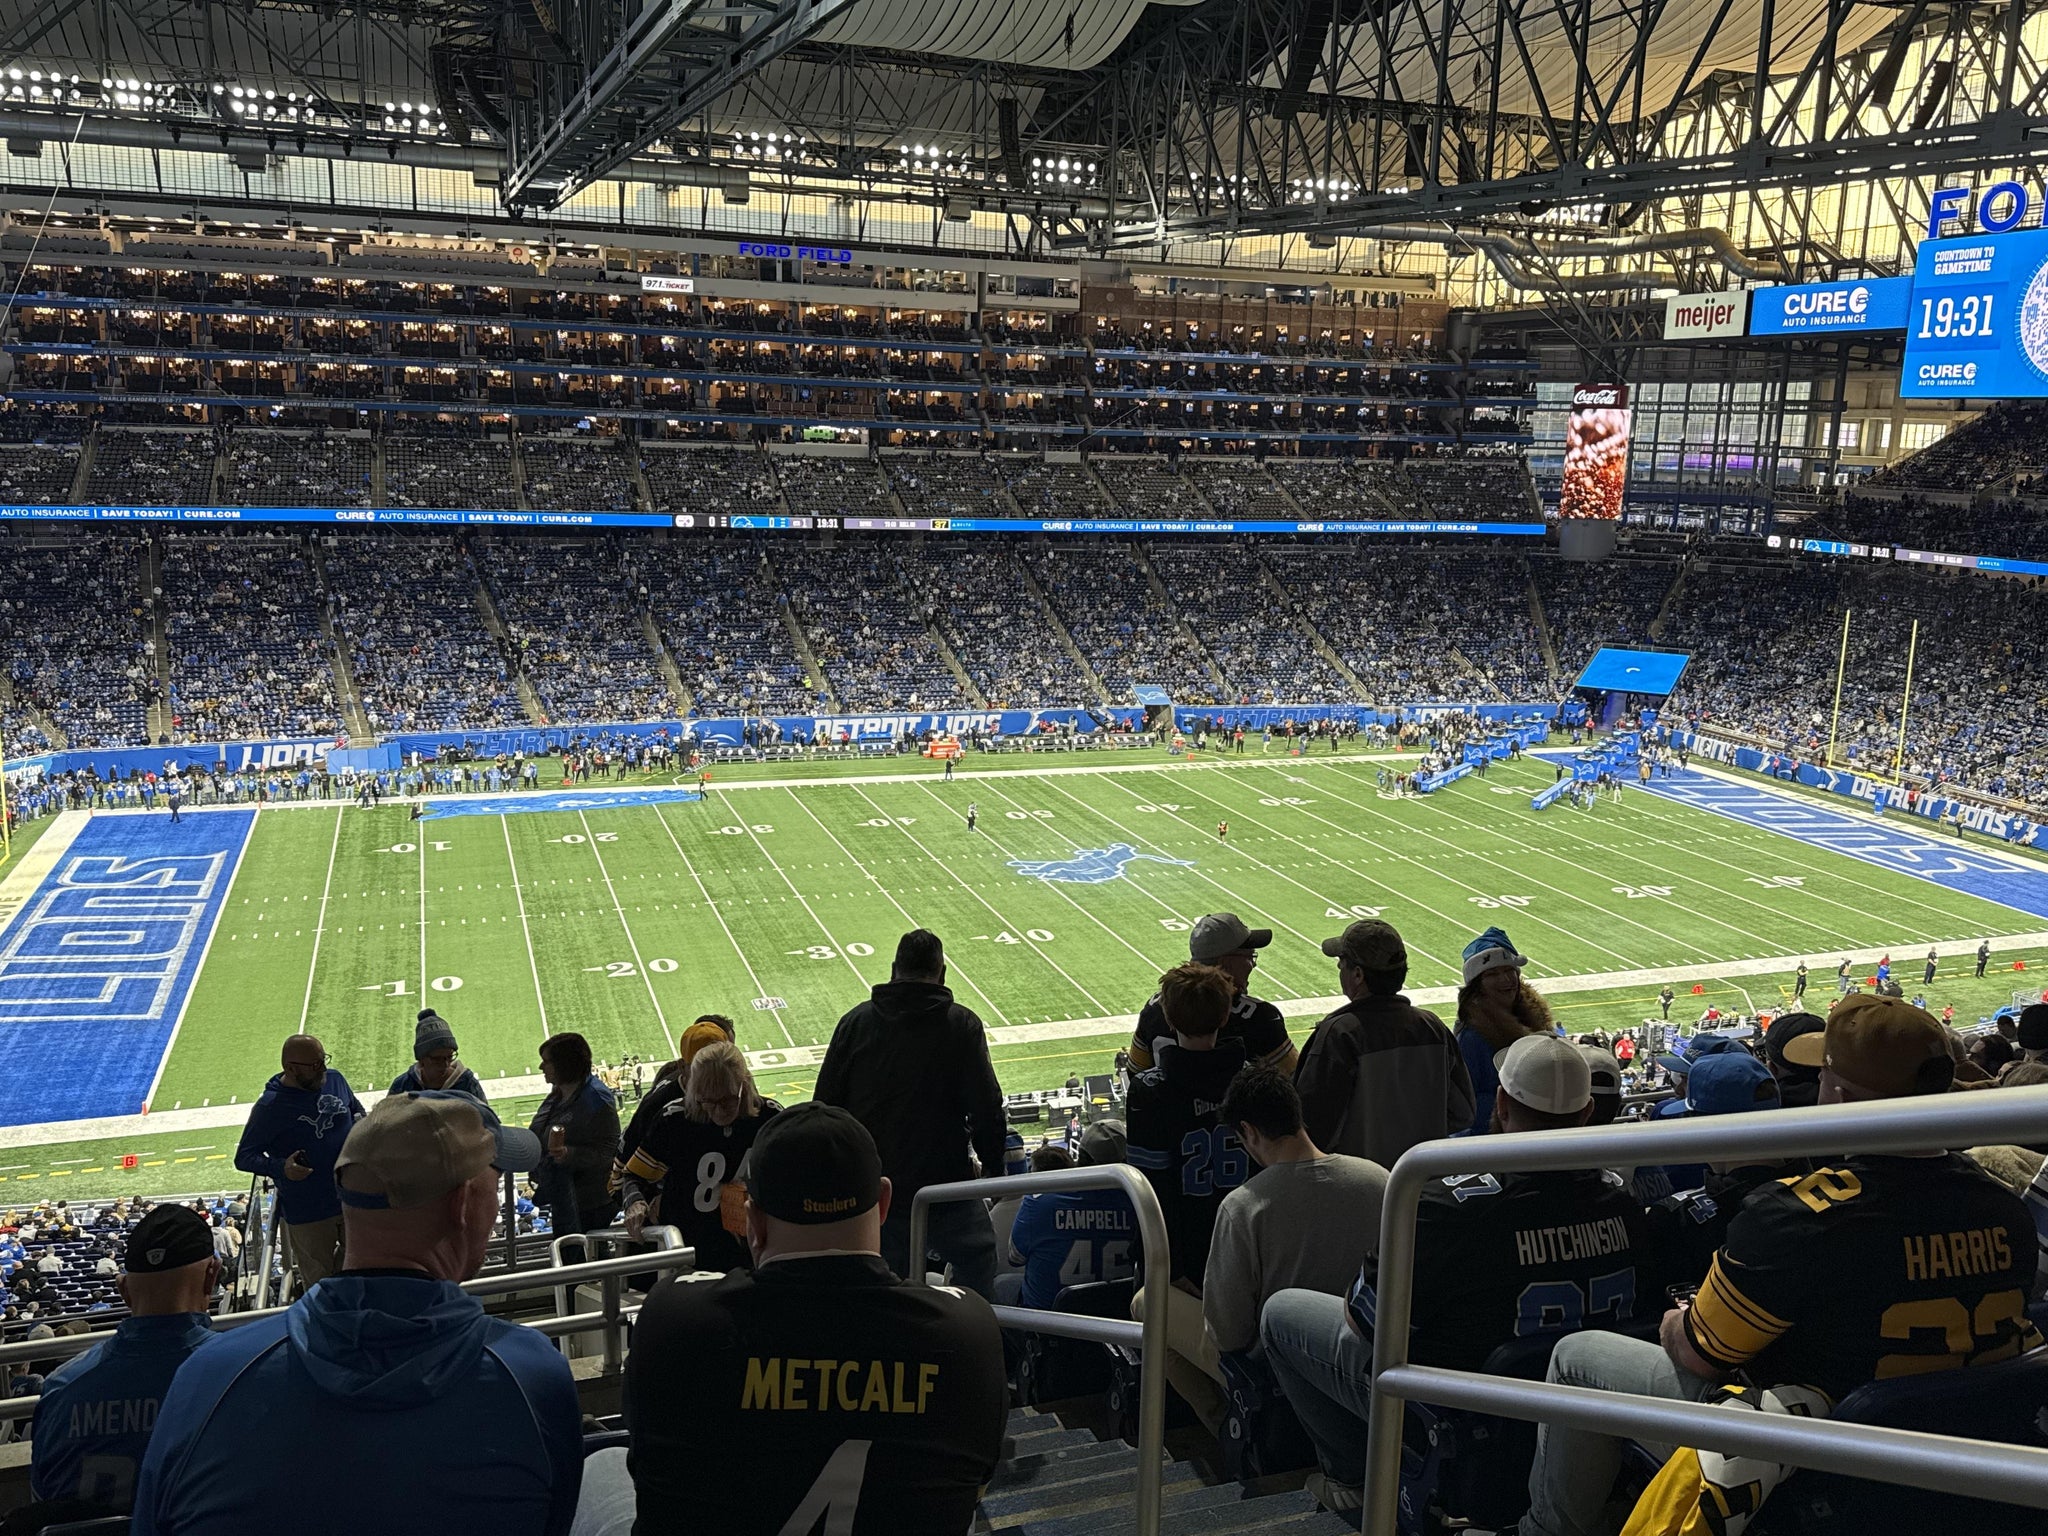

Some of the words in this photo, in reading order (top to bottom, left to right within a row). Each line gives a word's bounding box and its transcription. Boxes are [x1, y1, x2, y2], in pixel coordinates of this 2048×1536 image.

[1928, 181, 2048, 239] FO
[739, 243, 791, 258] FORD
[798, 247, 852, 262] FIELD
[1935, 247, 1983, 262] COUNTDOWN
[1983, 246, 1995, 258] TO
[1935, 259, 1992, 275] GAMETIME
[646, 280, 662, 288] 97.1
[1675, 298, 1735, 332] meijer
[1782, 317, 1807, 327] AUTO
[1810, 314, 1867, 326] INSURANCE
[1918, 295, 1994, 339] 19:31
[32, 509, 90, 517] INSURANCE
[102, 510, 130, 518] SAVE
[133, 510, 173, 518] TODAY!
[379, 512, 403, 520] AUTO
[406, 512, 458, 521] INSURANCE
[497, 514, 532, 522] TODAY!
[542, 515, 592, 523] CURE.COM
[934, 520, 946, 528] 37
[1075, 522, 1093, 530] AUTO
[1095, 522, 1133, 530] INSURANCE
[814, 715, 921, 742] DETROIT
[1223, 709, 1320, 732] DETROIT
[463, 728, 590, 758] DETROIT
[242, 740, 335, 771] LIONS
[1851, 777, 1940, 814] DETROIT
[1005, 809, 1055, 820] 50
[1135, 803, 1185, 814] 40
[721, 824, 775, 836] 30
[867, 816, 918, 828] 40
[391, 839, 453, 854] 10
[561, 832, 619, 845] 20
[1744, 874, 1804, 889] 10
[1611, 884, 1673, 899] 20
[1468, 894, 1533, 909] 30
[1325, 905, 1379, 920] 40
[1158, 917, 1201, 932] 5
[994, 929, 1055, 946] 40
[805, 942, 876, 960] 30
[606, 958, 679, 978] 20
[384, 975, 464, 997] 10
[125, 1156, 133, 1166] G
[1181, 1125, 1249, 1196] 26
[803, 1197, 857, 1213] Steelers
[1055, 1209, 1131, 1231] CAMPBELL
[1515, 1215, 1630, 1266] HUTCHINSON
[1903, 1226, 2012, 1281] HARRIS
[741, 1357, 939, 1414] METCALF
[776, 1439, 873, 1536] 4
